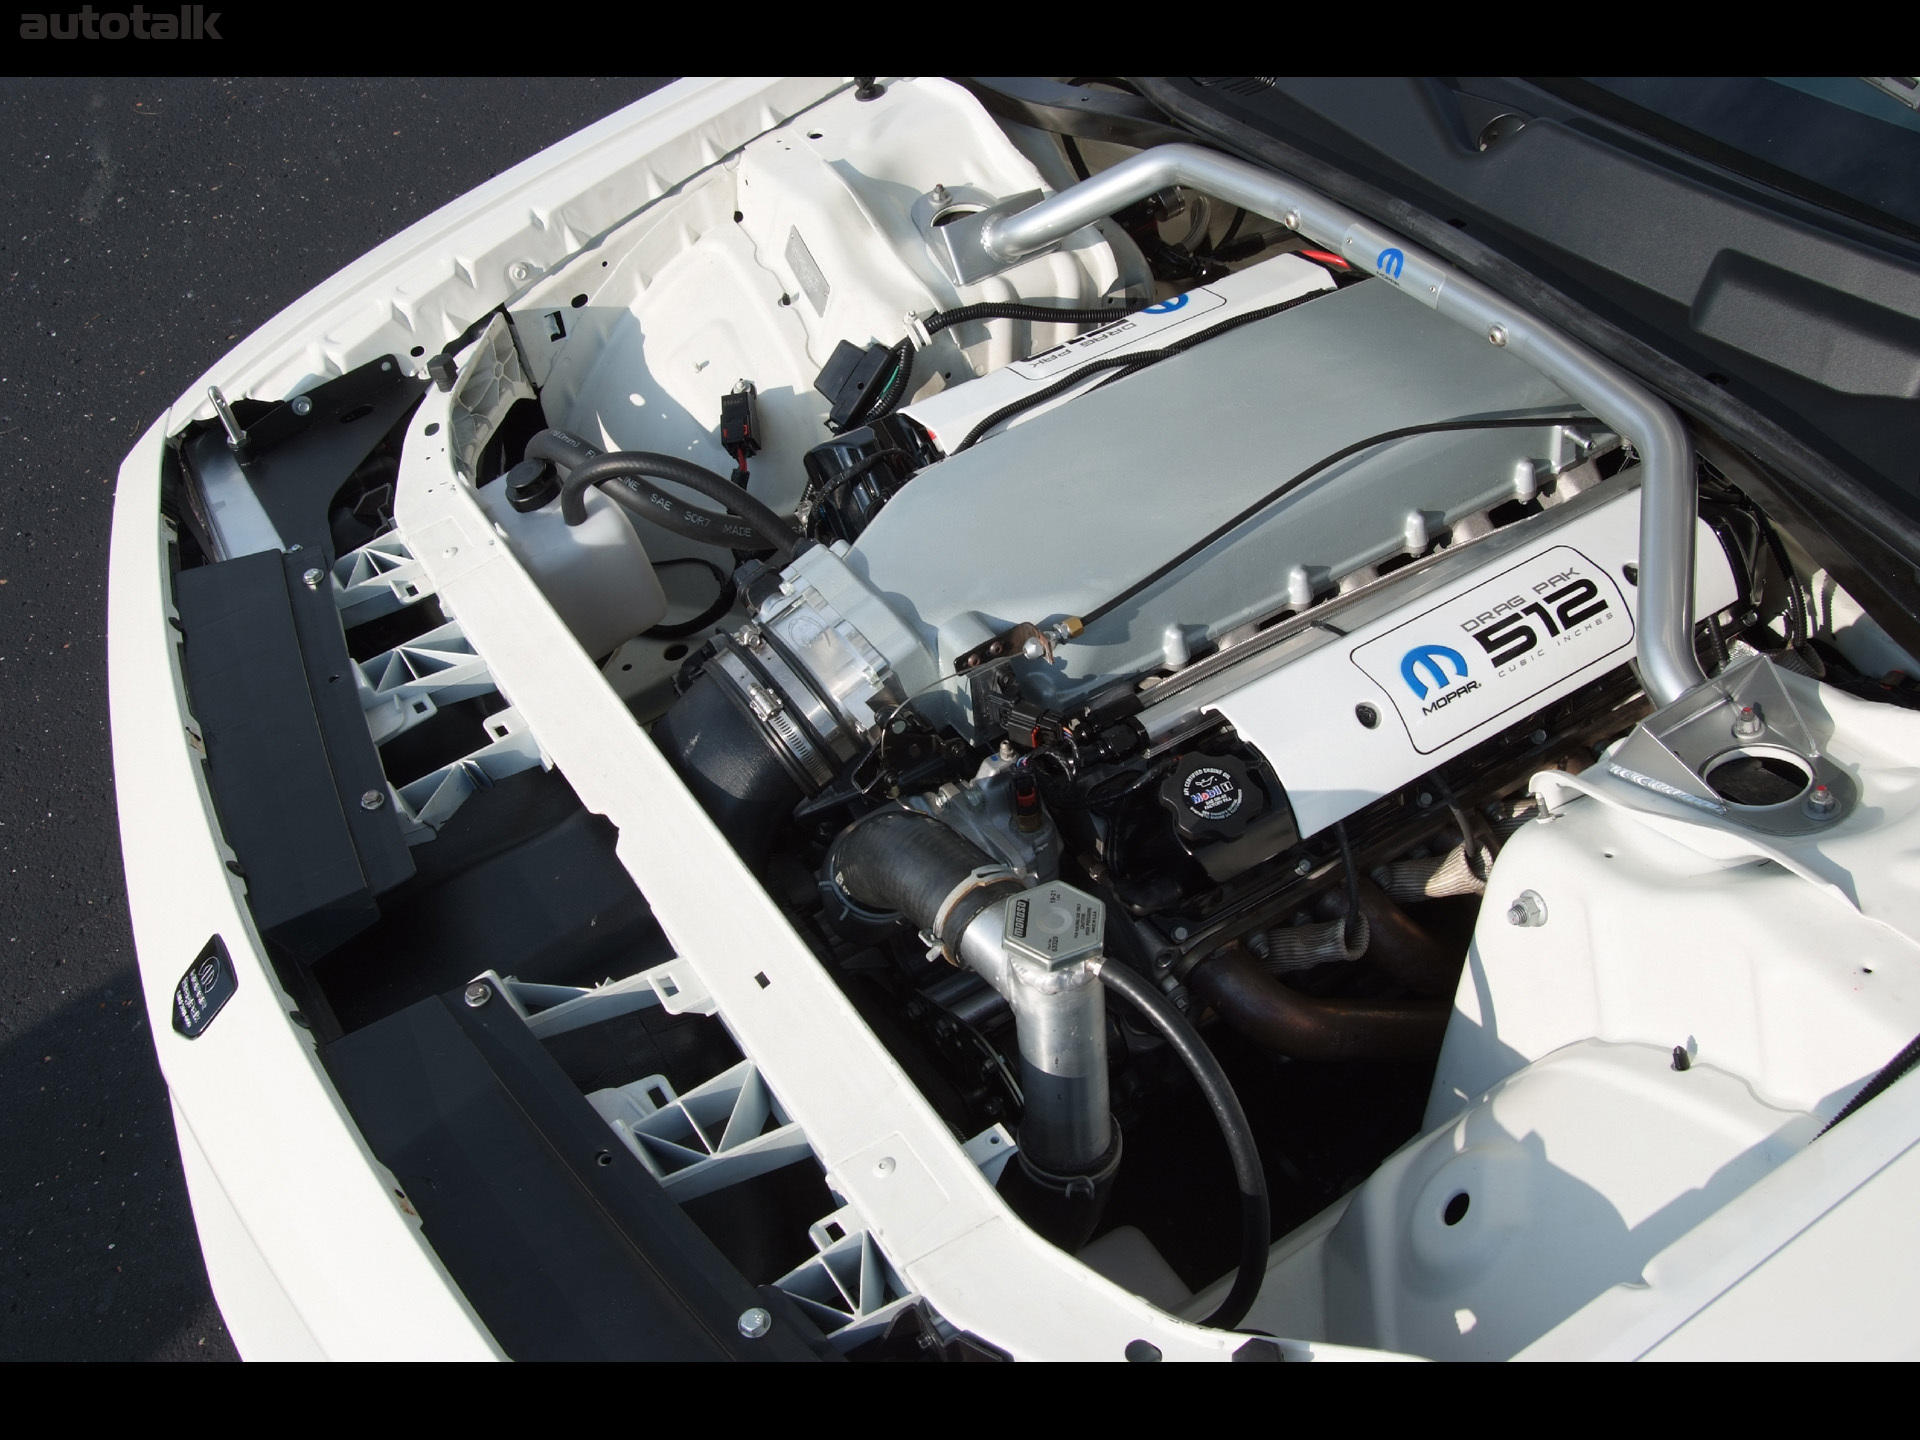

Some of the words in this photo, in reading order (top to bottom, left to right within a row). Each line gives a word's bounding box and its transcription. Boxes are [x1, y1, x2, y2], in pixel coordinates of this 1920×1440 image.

[1080, 322, 1137, 347] DRAG
[1029, 349, 1071, 368] PAK
[650, 493, 673, 512] SAE
[722, 523, 753, 538] MADE
[1459, 595, 1526, 633] DRAG
[1532, 567, 1580, 595] PAK
[1472, 578, 1609, 669] 512
[1498, 649, 1546, 678] CUBIC
[1556, 612, 1614, 647] INCHES
[1422, 681, 1482, 717] MOPAR
[1190, 785, 1222, 804] Mobil
[1013, 900, 1027, 938] MOROSO
